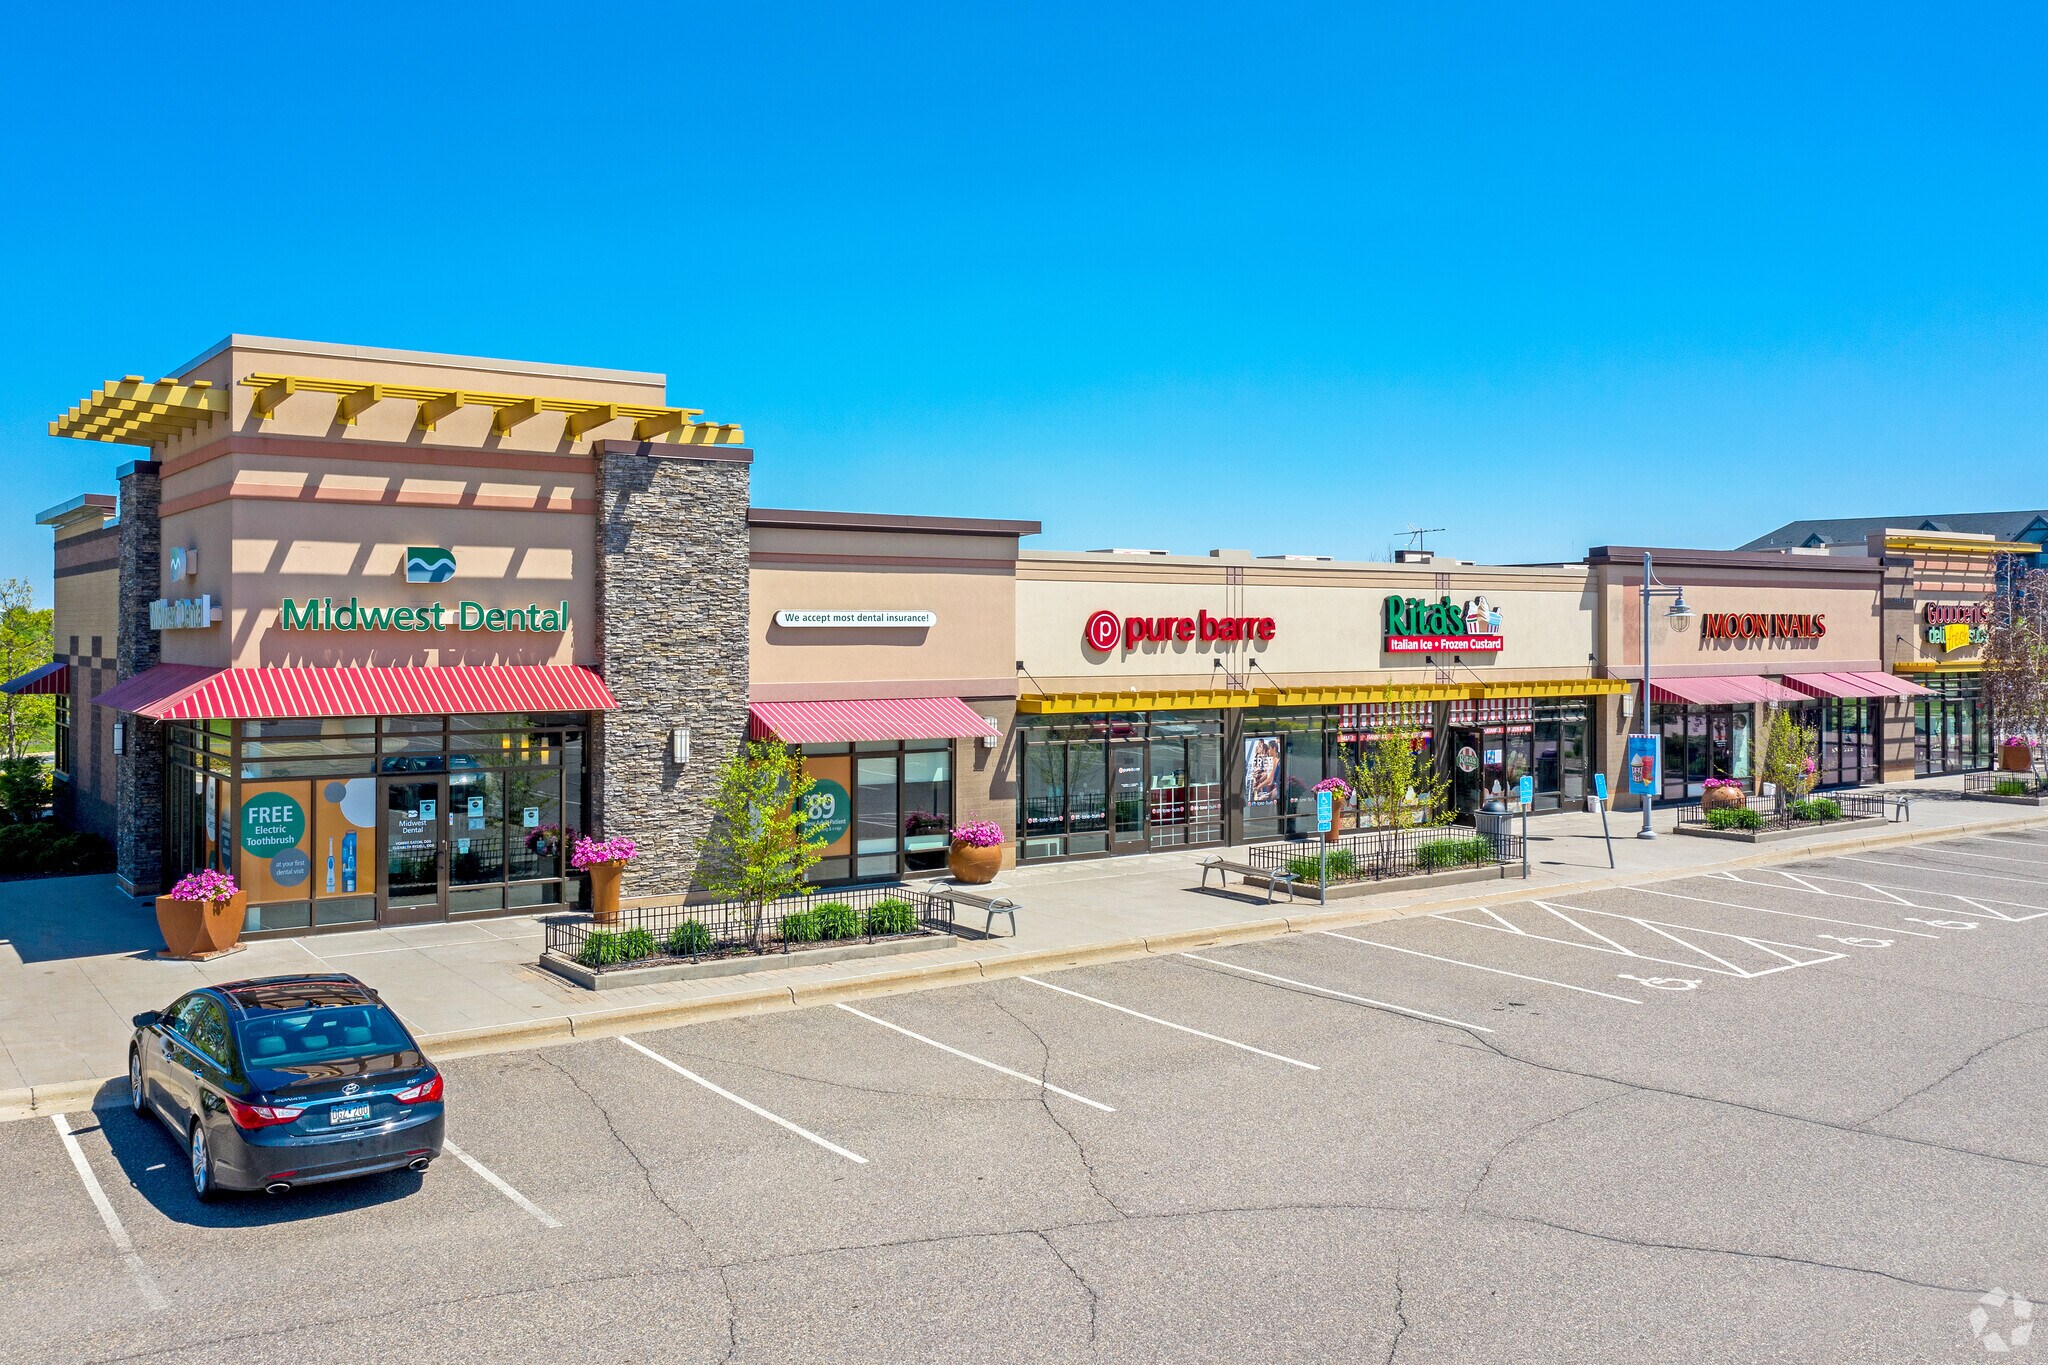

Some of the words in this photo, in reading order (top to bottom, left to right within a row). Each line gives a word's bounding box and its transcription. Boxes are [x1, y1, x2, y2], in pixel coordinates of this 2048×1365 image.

[281, 597, 446, 631] Midwest
[459, 600, 569, 632] Dental
[784, 613, 800, 622] We
[802, 613, 831, 624] accept
[833, 613, 855, 622] most
[857, 613, 884, 622] dental
[886, 613, 930, 622] insurance!
[1386, 594, 1465, 636] Rita's
[1125, 616, 1196, 650] pure
[1199, 609, 1276, 641] barre
[1704, 613, 1769, 639] MOON
[1772, 613, 1827, 638] NAILS
[1391, 639, 1419, 650] Italian
[1420, 639, 1433, 650] Ice
[1440, 638, 1469, 650] Frozen
[1470, 638, 1501, 649] Custard
[1928, 625, 1947, 644] deli
[1947, 625, 1969, 651] fresh
[248, 805, 294, 824] FREE
[246, 835, 295, 846] Toothbrush
[255, 825, 286, 835] Electric
